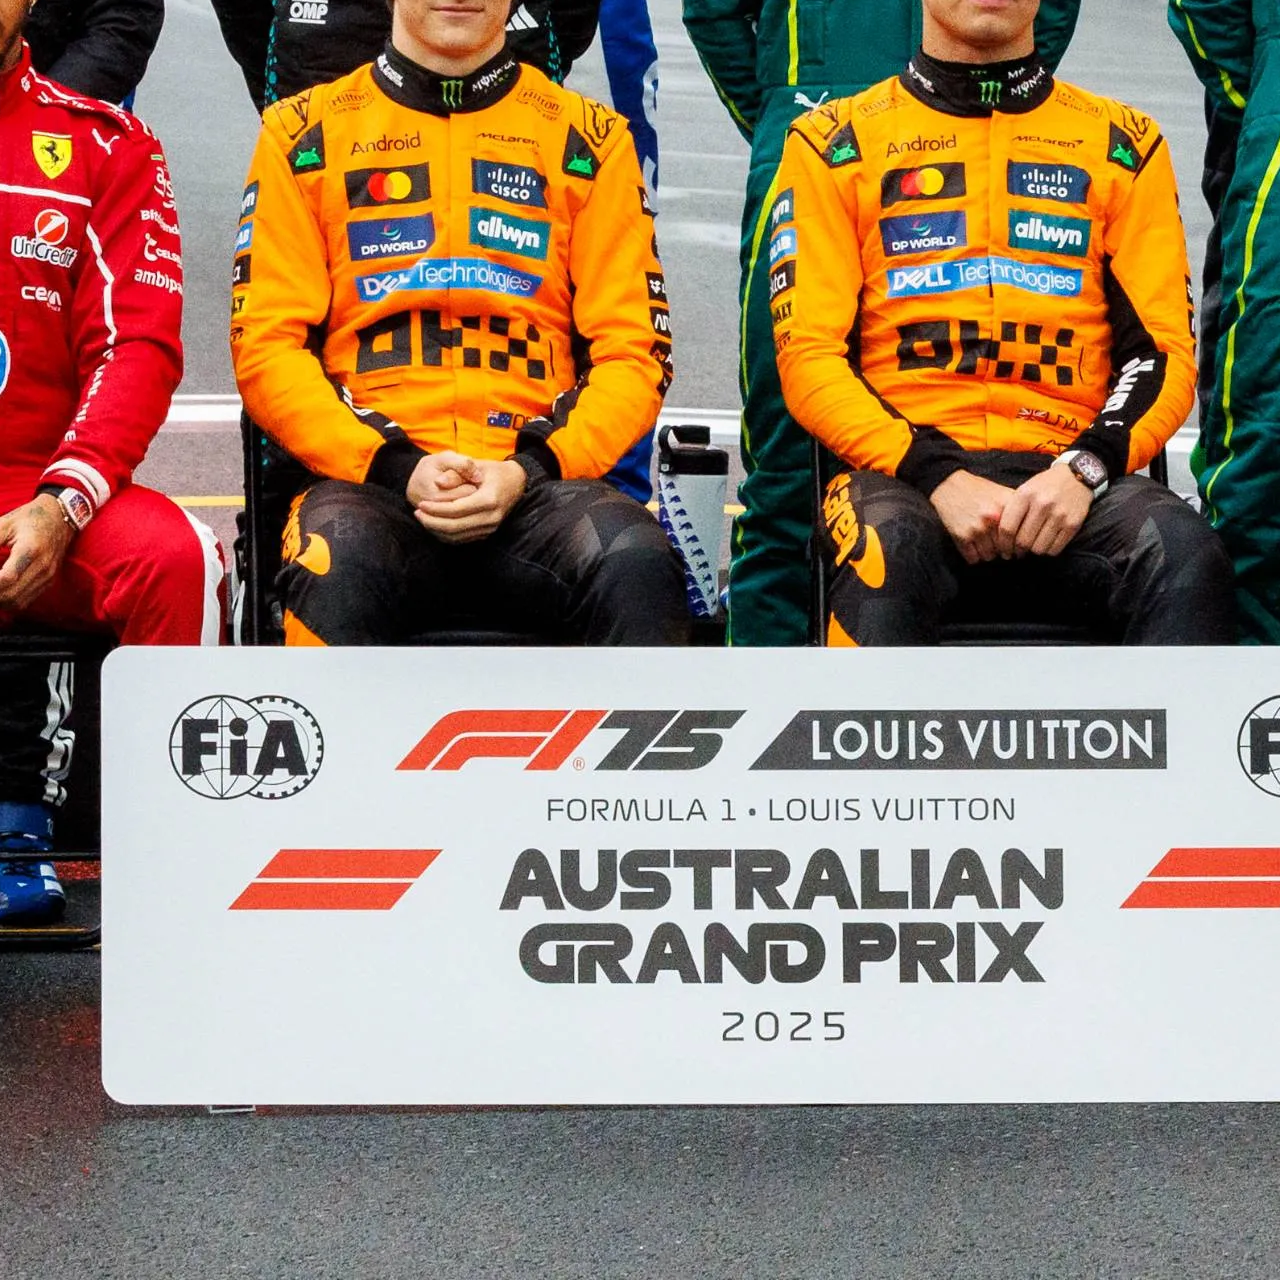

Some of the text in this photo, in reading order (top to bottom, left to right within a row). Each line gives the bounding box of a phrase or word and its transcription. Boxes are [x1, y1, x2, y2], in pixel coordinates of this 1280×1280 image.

[289, 2, 328, 20] OMP
[350, 131, 421, 155] Android
[886, 134, 957, 158] Android
[361, 240, 427, 255] DP WORLD
[478, 217, 540, 249] allwyn
[892, 236, 957, 251] DP WORLD
[1015, 217, 1083, 248] allwyn
[11, 237, 78, 267] UniCredit
[417, 261, 533, 292] Technologies
[893, 262, 1076, 292] DELL Technologies
[812, 719, 1154, 761] LOUIS VUITTON
[547, 797, 1015, 822] FORMULA 1 LOUIS VUITTON
[498, 848, 1064, 910] AUSTRALIAN
[519, 921, 1045, 984] GRAND PRIX
[722, 1011, 845, 1042] 2025
